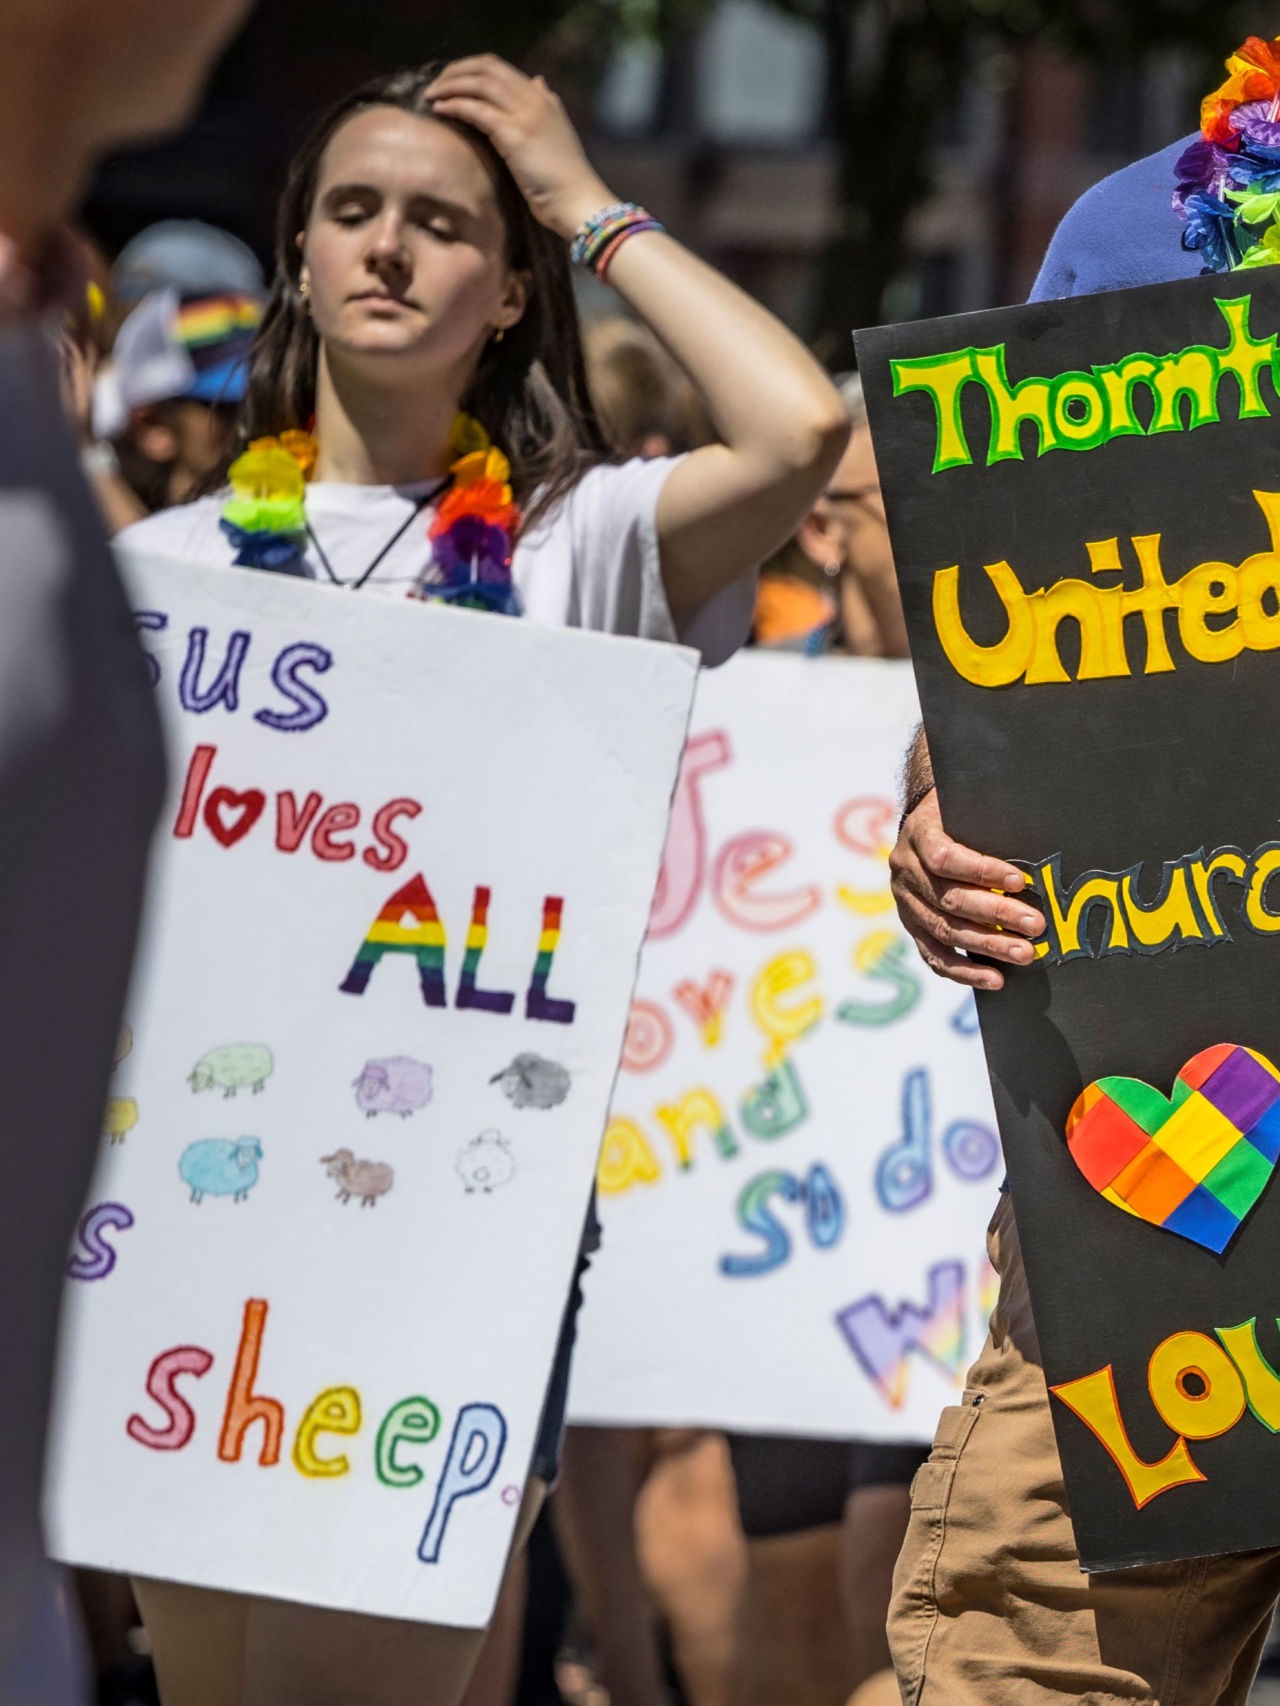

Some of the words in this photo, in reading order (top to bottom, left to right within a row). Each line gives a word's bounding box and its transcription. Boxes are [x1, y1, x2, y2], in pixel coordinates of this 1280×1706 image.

[648, 730, 896, 940] Jes
[338, 872, 577, 1024] ALL
[616, 929, 922, 1074] oves
[595, 1048, 810, 1196] and
[874, 1066, 1001, 1214] do
[126, 1298, 507, 1564] sheep
